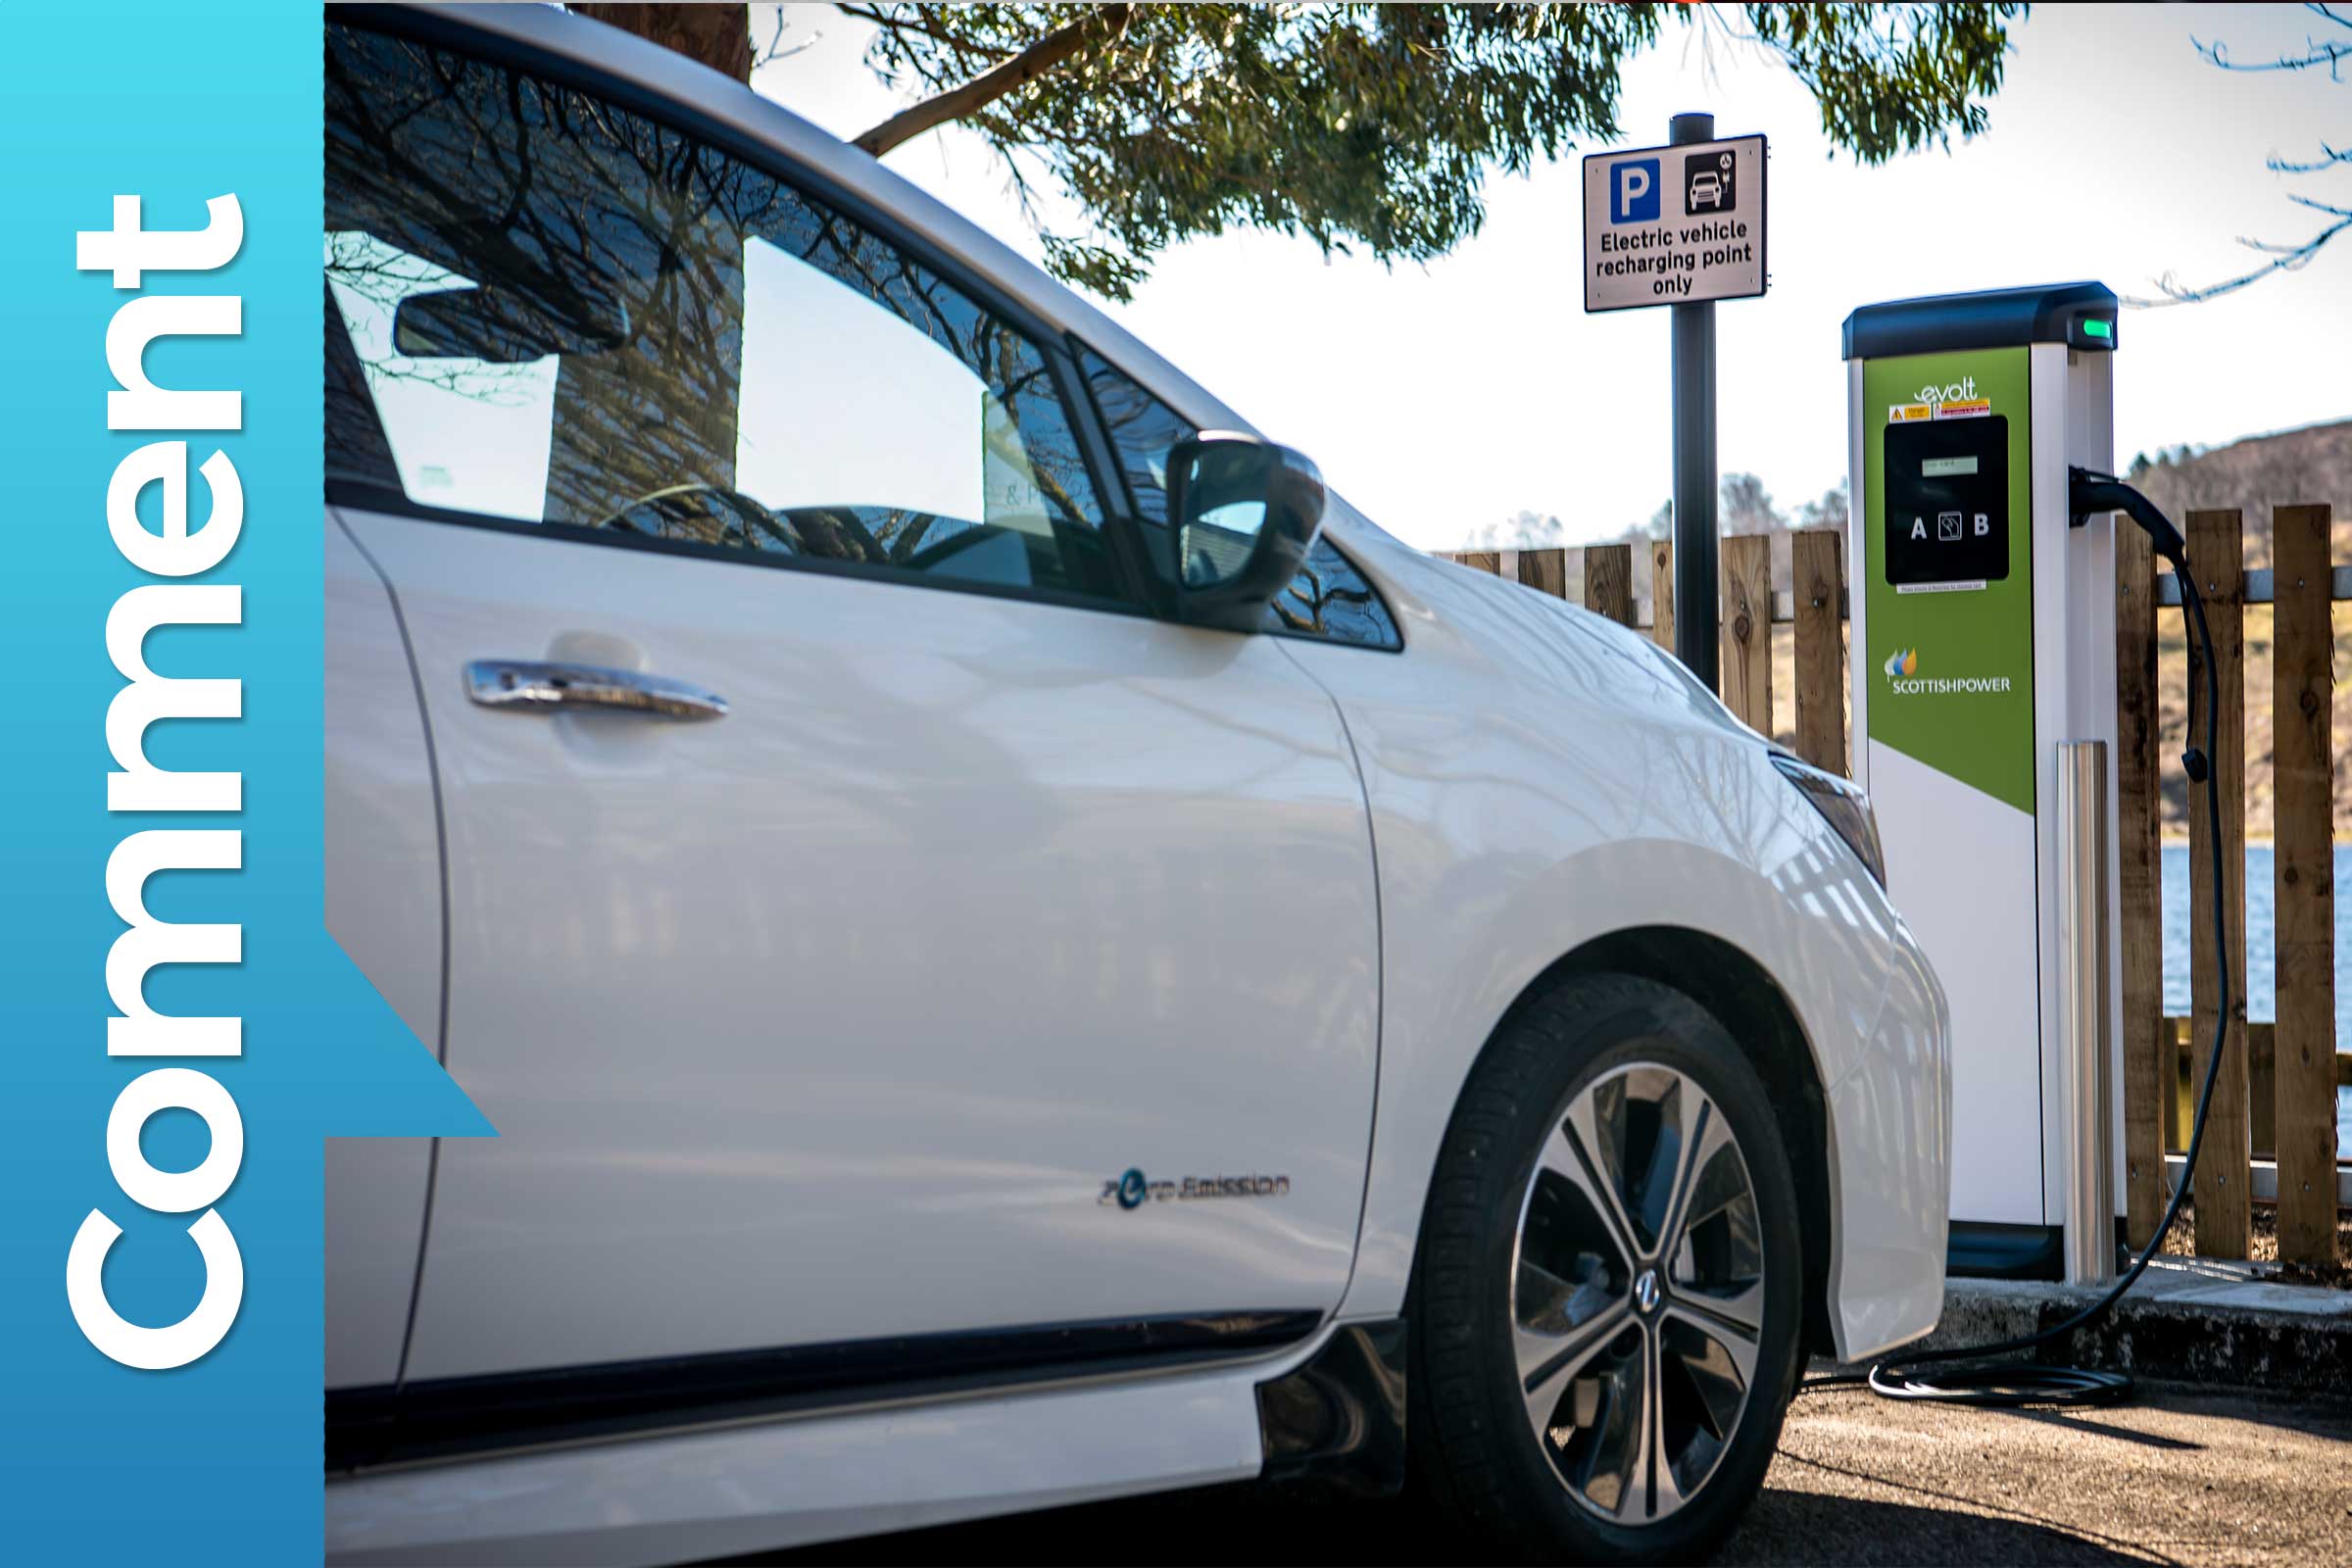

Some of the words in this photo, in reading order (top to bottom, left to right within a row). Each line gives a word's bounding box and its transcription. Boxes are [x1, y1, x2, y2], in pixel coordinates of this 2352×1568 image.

[1621, 166, 1650, 218] P
[1600, 226, 1674, 254] Electric
[1680, 219, 1747, 244] vehicle
[1595, 250, 1695, 277] recharging
[1702, 242, 1752, 270] point
[1652, 274, 1693, 296] only
[1910, 515, 1928, 540] A
[1974, 512, 1989, 537] B
[1892, 677, 2011, 695] SCOTTISHPOWER
